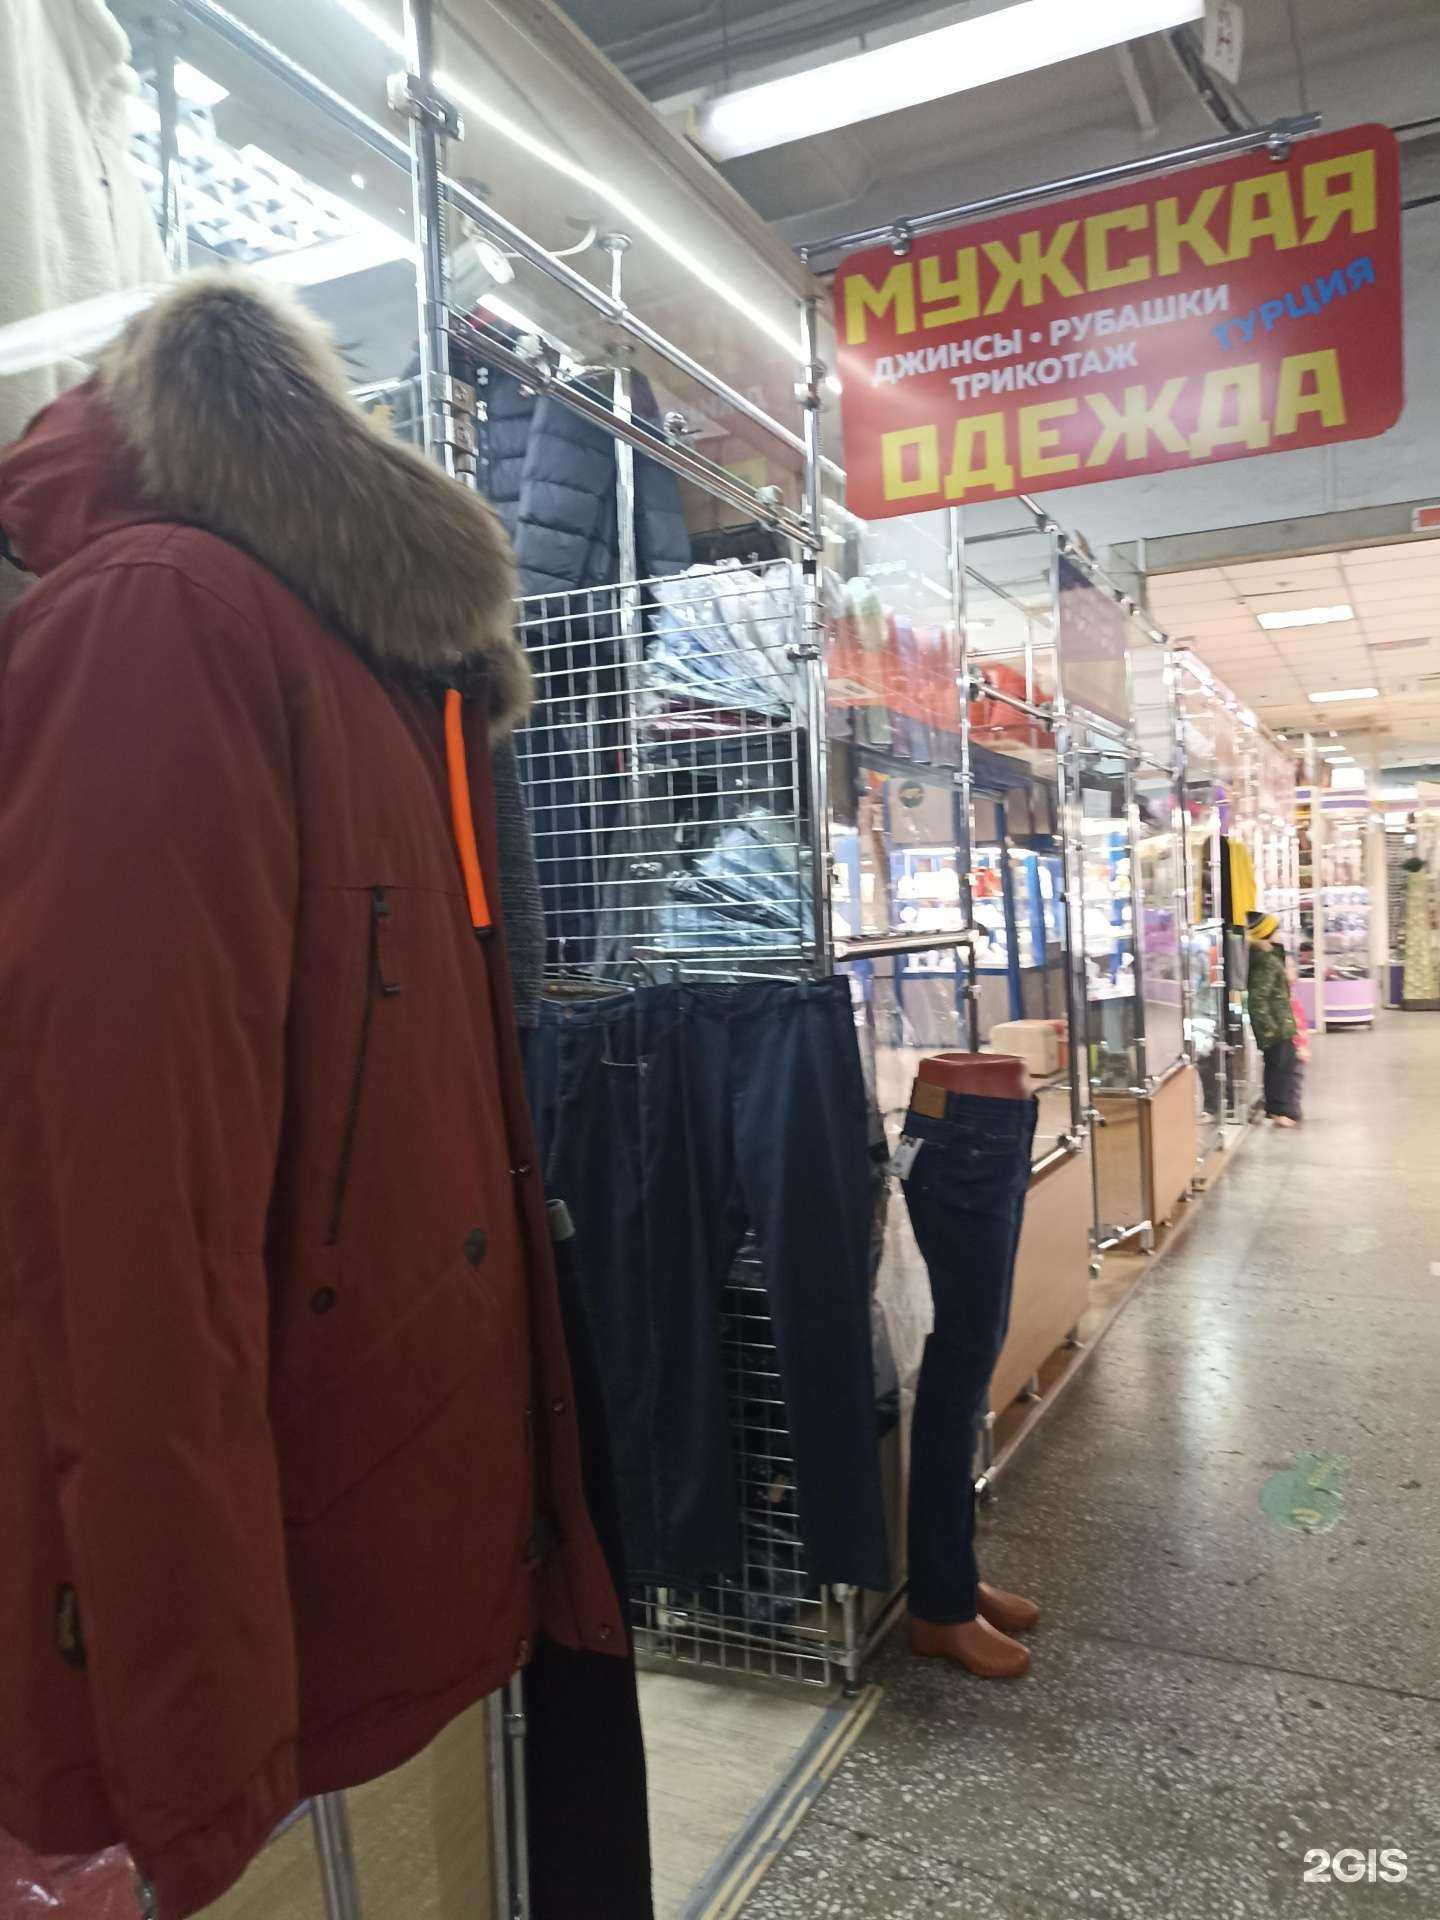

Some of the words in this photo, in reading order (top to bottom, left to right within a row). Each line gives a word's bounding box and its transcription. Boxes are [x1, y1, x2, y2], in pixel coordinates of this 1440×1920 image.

[844, 149, 1377, 344] МУЖСКАЯ
[872, 329, 1022, 387] ДЖИНСЫ
[1050, 285, 1230, 346] РУБАШКИ
[1213, 256, 1377, 352] ТУРЦИЯ
[951, 340, 1138, 401] ТРИКОТАЖ
[881, 348, 1347, 501] ОДЕЖДА
